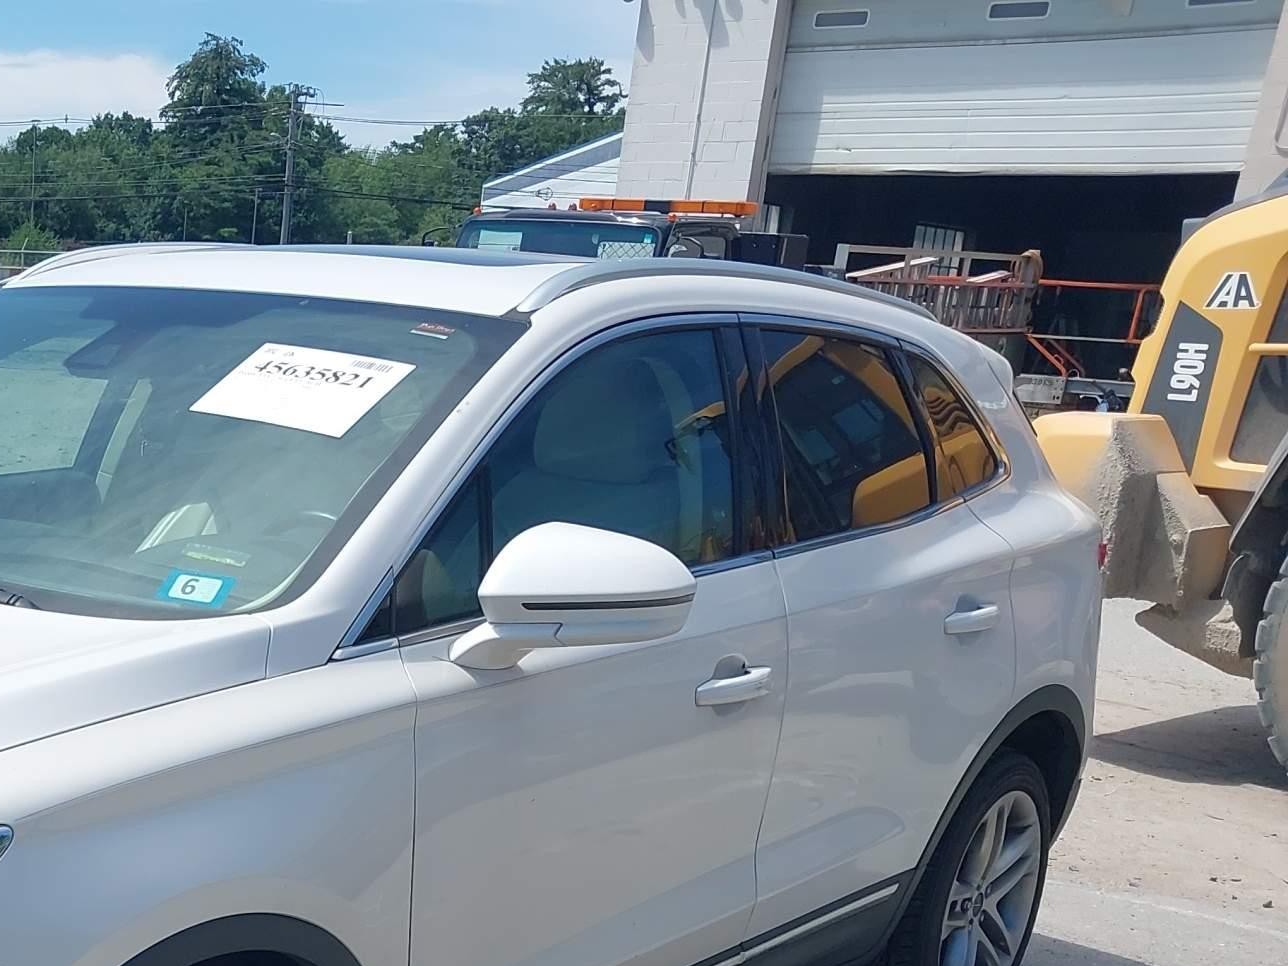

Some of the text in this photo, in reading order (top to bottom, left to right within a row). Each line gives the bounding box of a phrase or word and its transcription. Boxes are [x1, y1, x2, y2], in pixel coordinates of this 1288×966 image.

[254, 360, 375, 390] 45635821
[1167, 342, 1210, 402] L90H
[180, 578, 200, 595] 6
